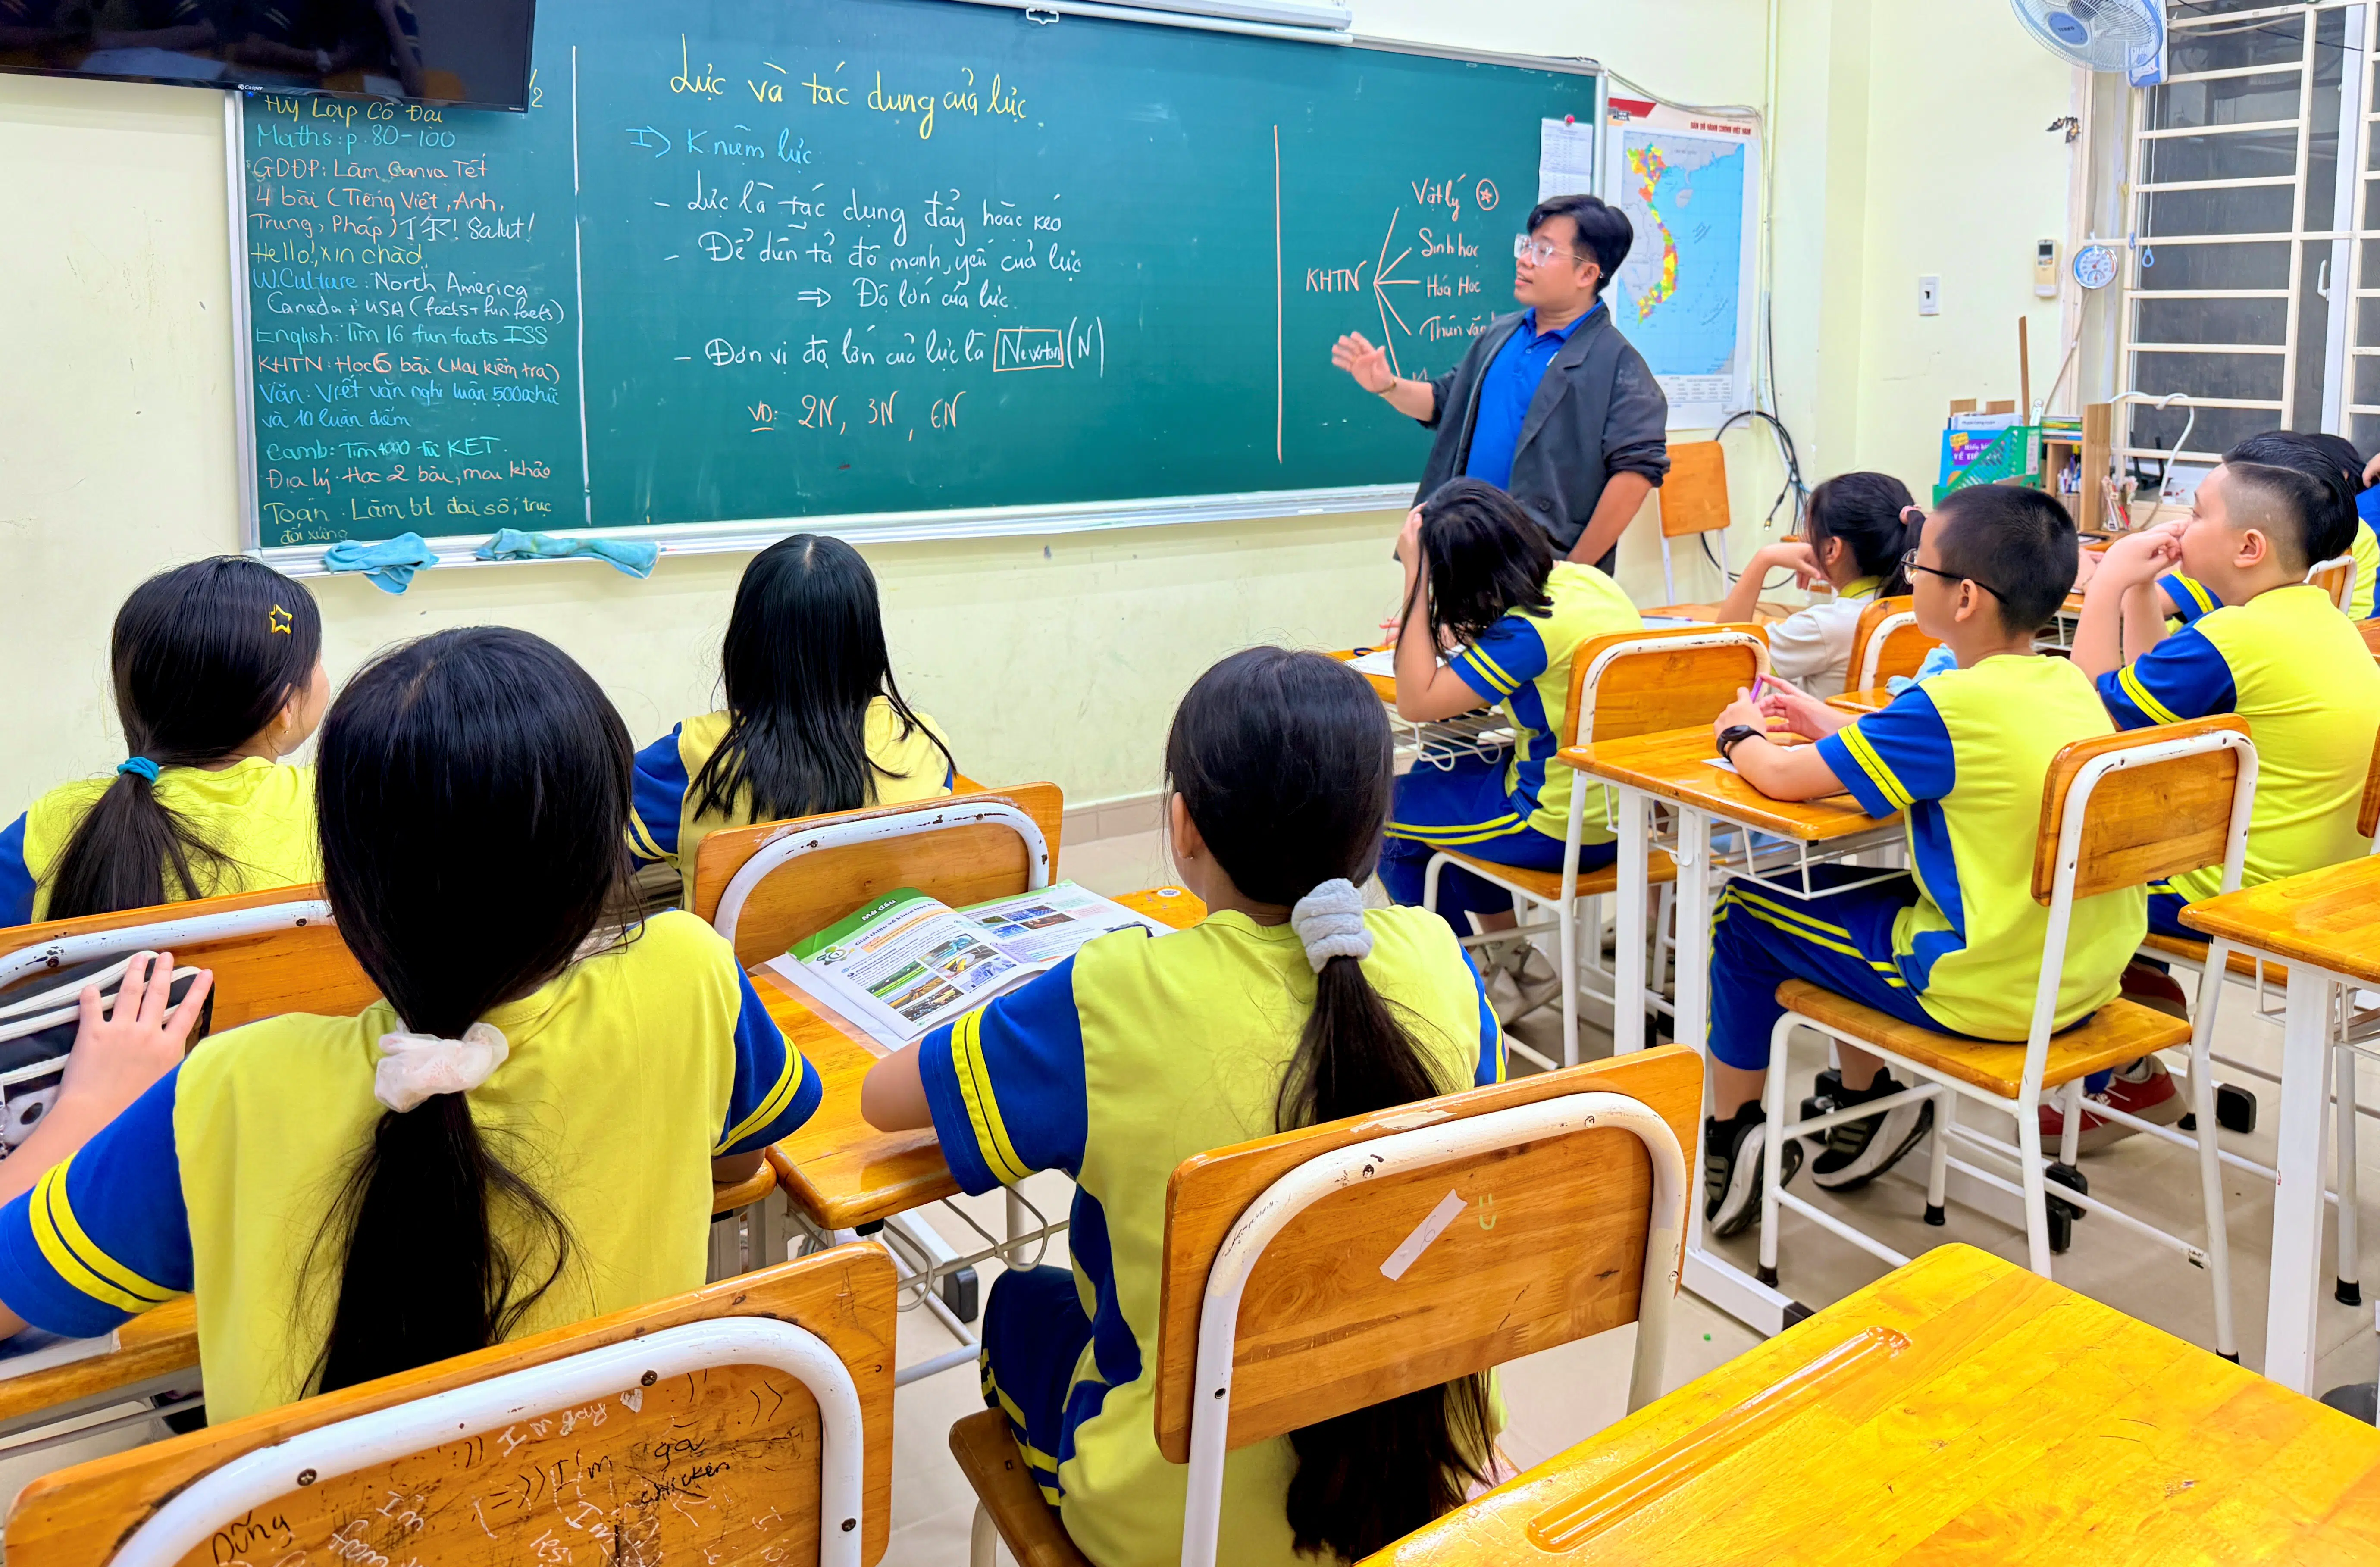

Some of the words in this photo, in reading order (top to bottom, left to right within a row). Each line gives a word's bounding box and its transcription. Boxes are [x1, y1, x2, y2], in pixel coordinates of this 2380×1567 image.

[748, 61, 788, 102] và
[802, 61, 849, 105] tác
[986, 73, 1027, 122] lực
[312, 97, 358, 128] Lạp
[335, 158, 381, 179] Làm
[388, 161, 449, 178] Canva
[453, 153, 489, 178] Tết
[256, 185, 270, 207] 4
[282, 185, 320, 208] bài
[739, 180, 774, 213] là
[778, 183, 826, 217] tác
[843, 188, 907, 247] dụng
[698, 228, 754, 261] Để
[805, 231, 835, 264] tả
[1001, 239, 1037, 272] của
[374, 270, 437, 291] North
[447, 271, 528, 298] America
[1306, 260, 1367, 293] KHTN
[267, 291, 342, 316] Canada
[366, 300, 404, 317] USA
[483, 294, 510, 317] fun
[387, 324, 403, 344] 16
[412, 323, 447, 344] fun
[451, 326, 498, 345] facts
[503, 325, 548, 344] ISS
[1002, 325, 1062, 366] Newton
[1067, 316, 1104, 378] (N)
[373, 352, 392, 373] 6
[400, 356, 432, 375] bài
[314, 374, 364, 403] Viết
[369, 378, 407, 400] văn
[261, 411, 289, 428] và
[294, 409, 314, 426] 10
[386, 464, 409, 482] 2
[351, 498, 406, 520] Làm
[522, 497, 552, 517] trục
[560, 1403, 608, 1436] gay
[212, 1510, 293, 1565] Dũng
